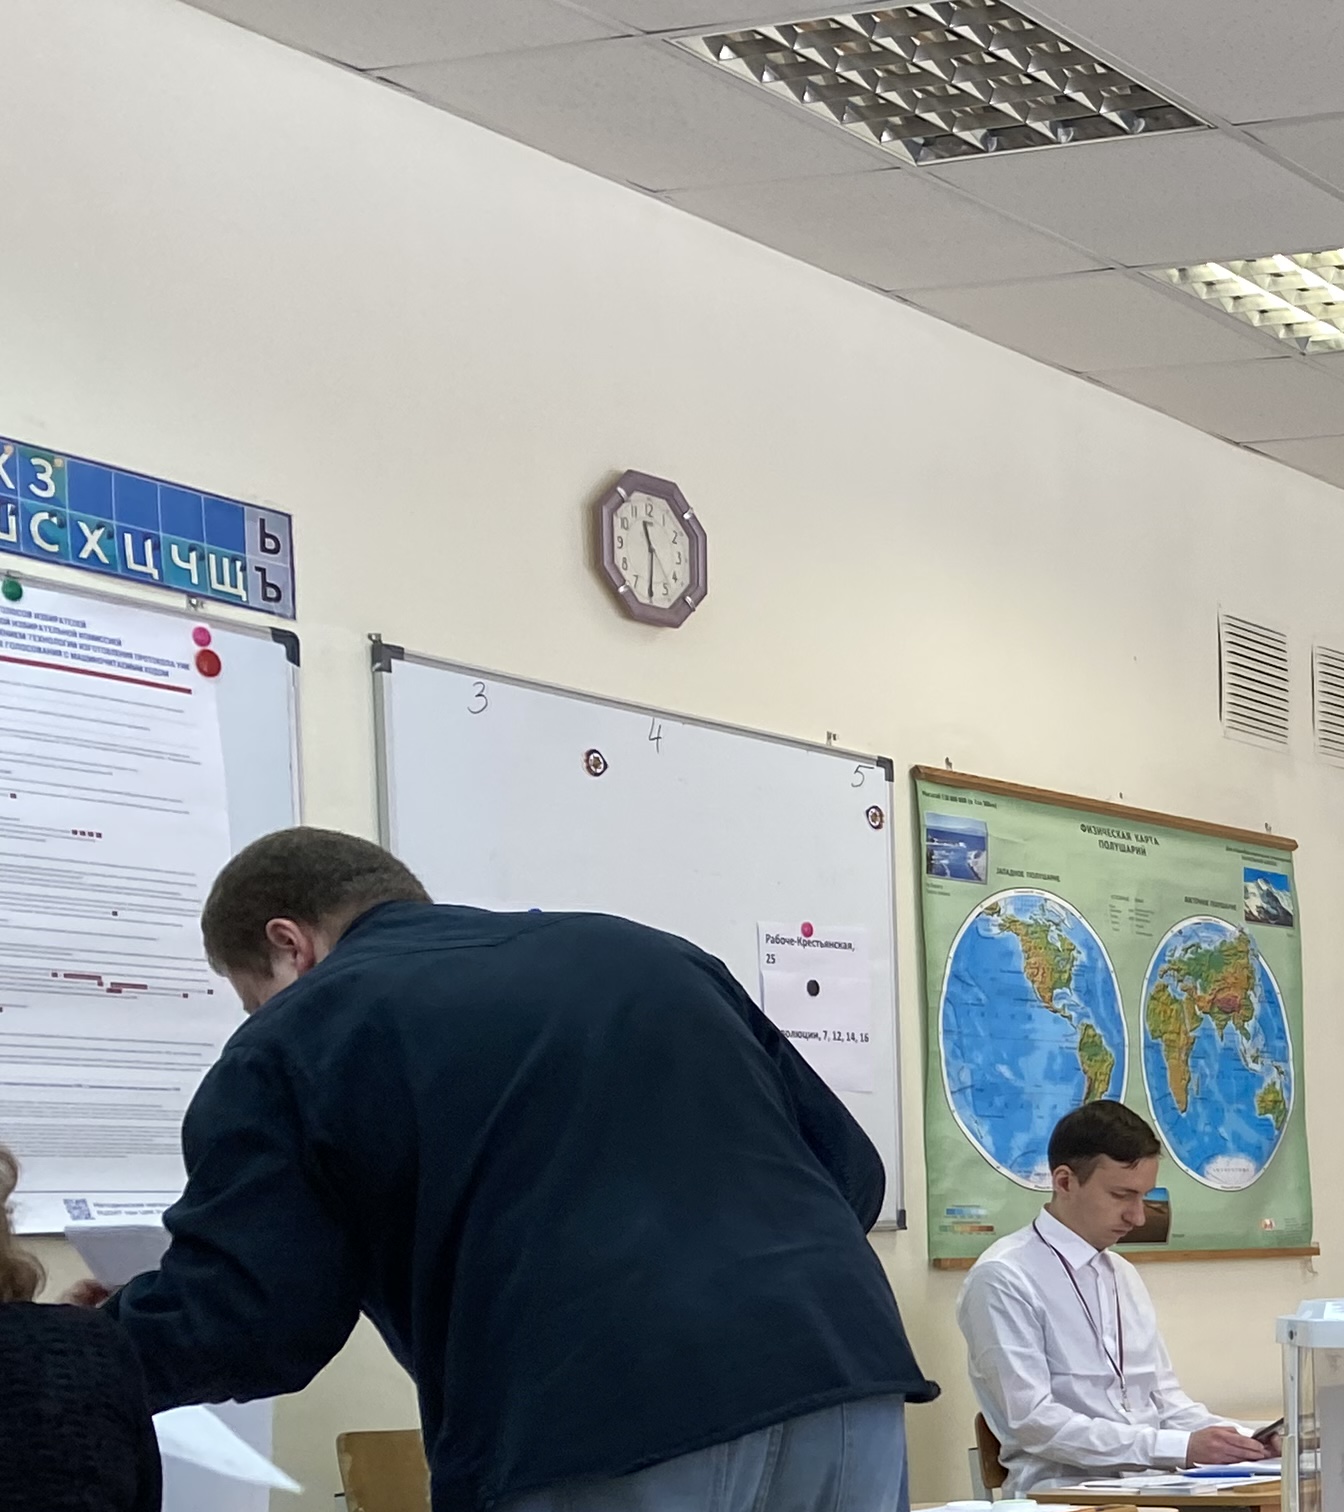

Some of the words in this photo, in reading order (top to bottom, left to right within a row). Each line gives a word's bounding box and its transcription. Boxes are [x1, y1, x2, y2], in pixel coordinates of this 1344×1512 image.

[631, 504, 638, 519] 11
[645, 503, 654, 518] 12
[620, 517, 629, 531] 10
[617, 536, 623, 549] 9
[672, 530, 678, 545] 2
[621, 556, 628, 571] 8
[675, 551, 682, 565] 3
[123, 533, 159, 580] Ц
[170, 544, 199, 585] Ч
[208, 553, 248, 602] Щ
[633, 574, 639, 589] 7
[672, 571, 678, 583] 4
[662, 582, 669, 596] 5
[467, 681, 488, 714] 3
[648, 718, 662, 753] 4
[851, 764, 875, 788] 5
[1080, 823, 1132, 841] ФИЗИЧЕСКАЯ
[1135, 833, 1160, 846] КАРТА
[765, 933, 855, 952] Рабоче-Крестьянская,
[766, 953, 776, 964] 25
